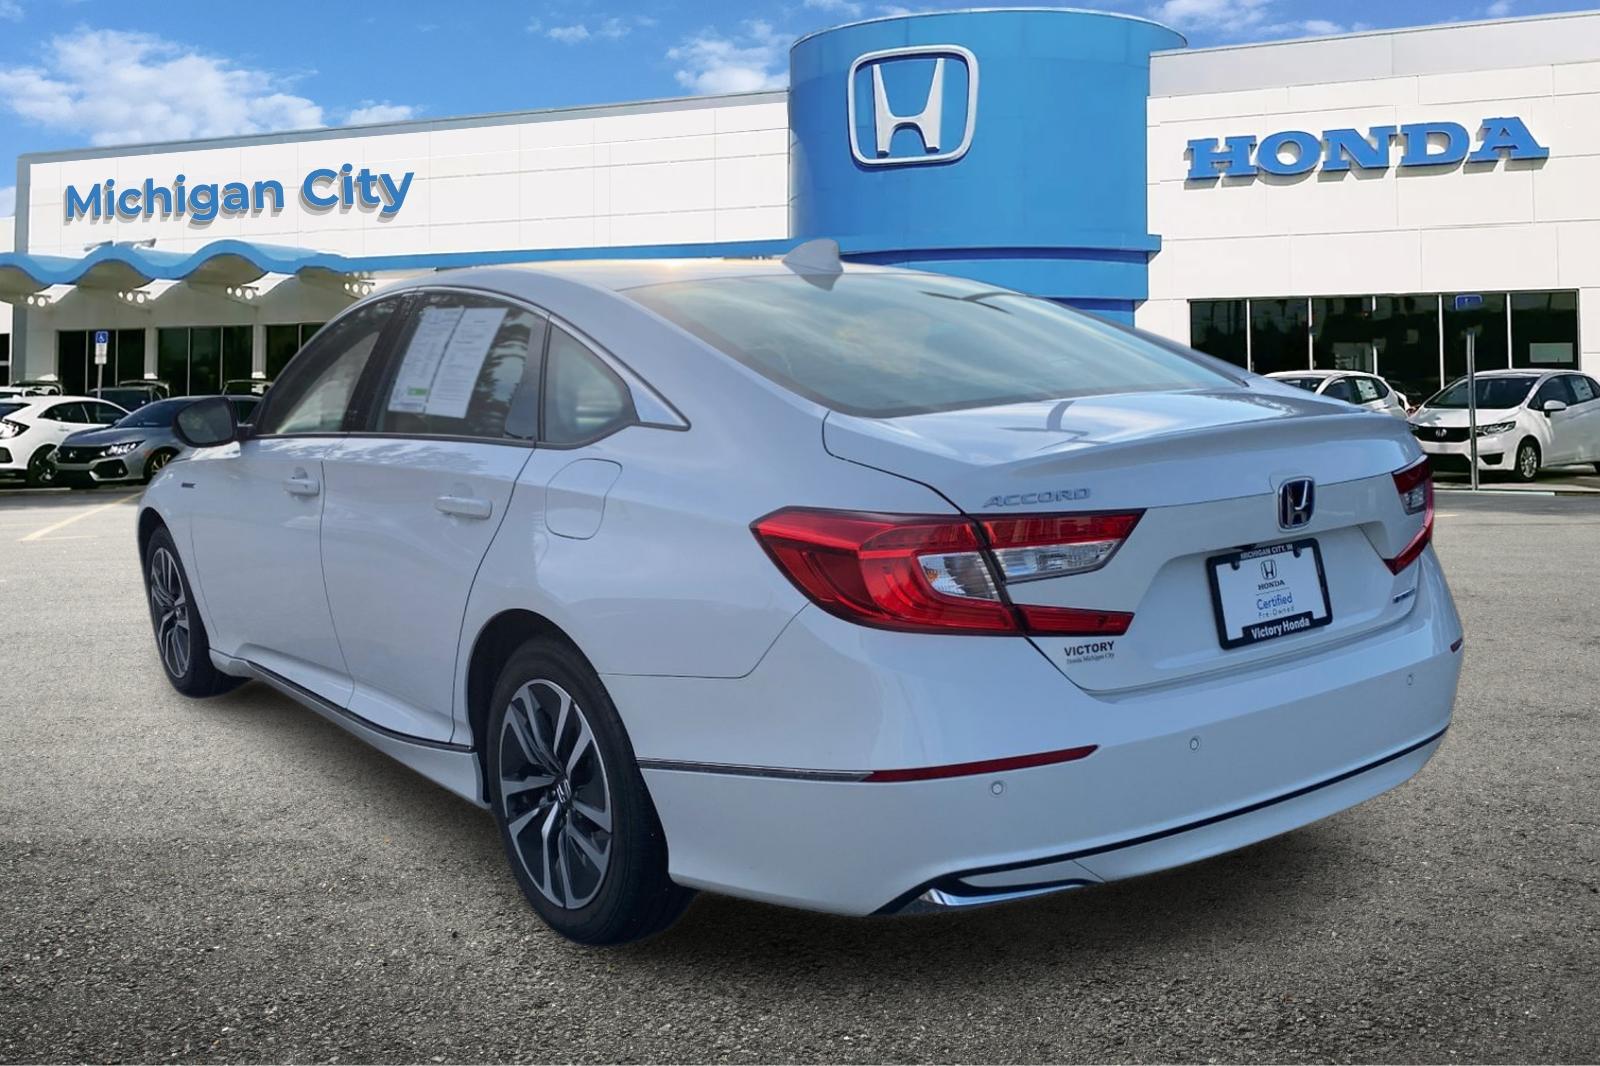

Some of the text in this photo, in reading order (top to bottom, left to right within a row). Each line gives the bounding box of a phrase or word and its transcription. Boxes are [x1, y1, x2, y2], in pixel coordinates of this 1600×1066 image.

[1186, 116, 1550, 180] HONDA
[65, 163, 415, 221] Michigan City
[982, 488, 1090, 508] ACCORD
[1258, 579, 1286, 591] HONDA
[1256, 592, 1293, 611] Certified
[1251, 617, 1310, 640] Victory Honda
[1064, 640, 1115, 657] VICTORY
